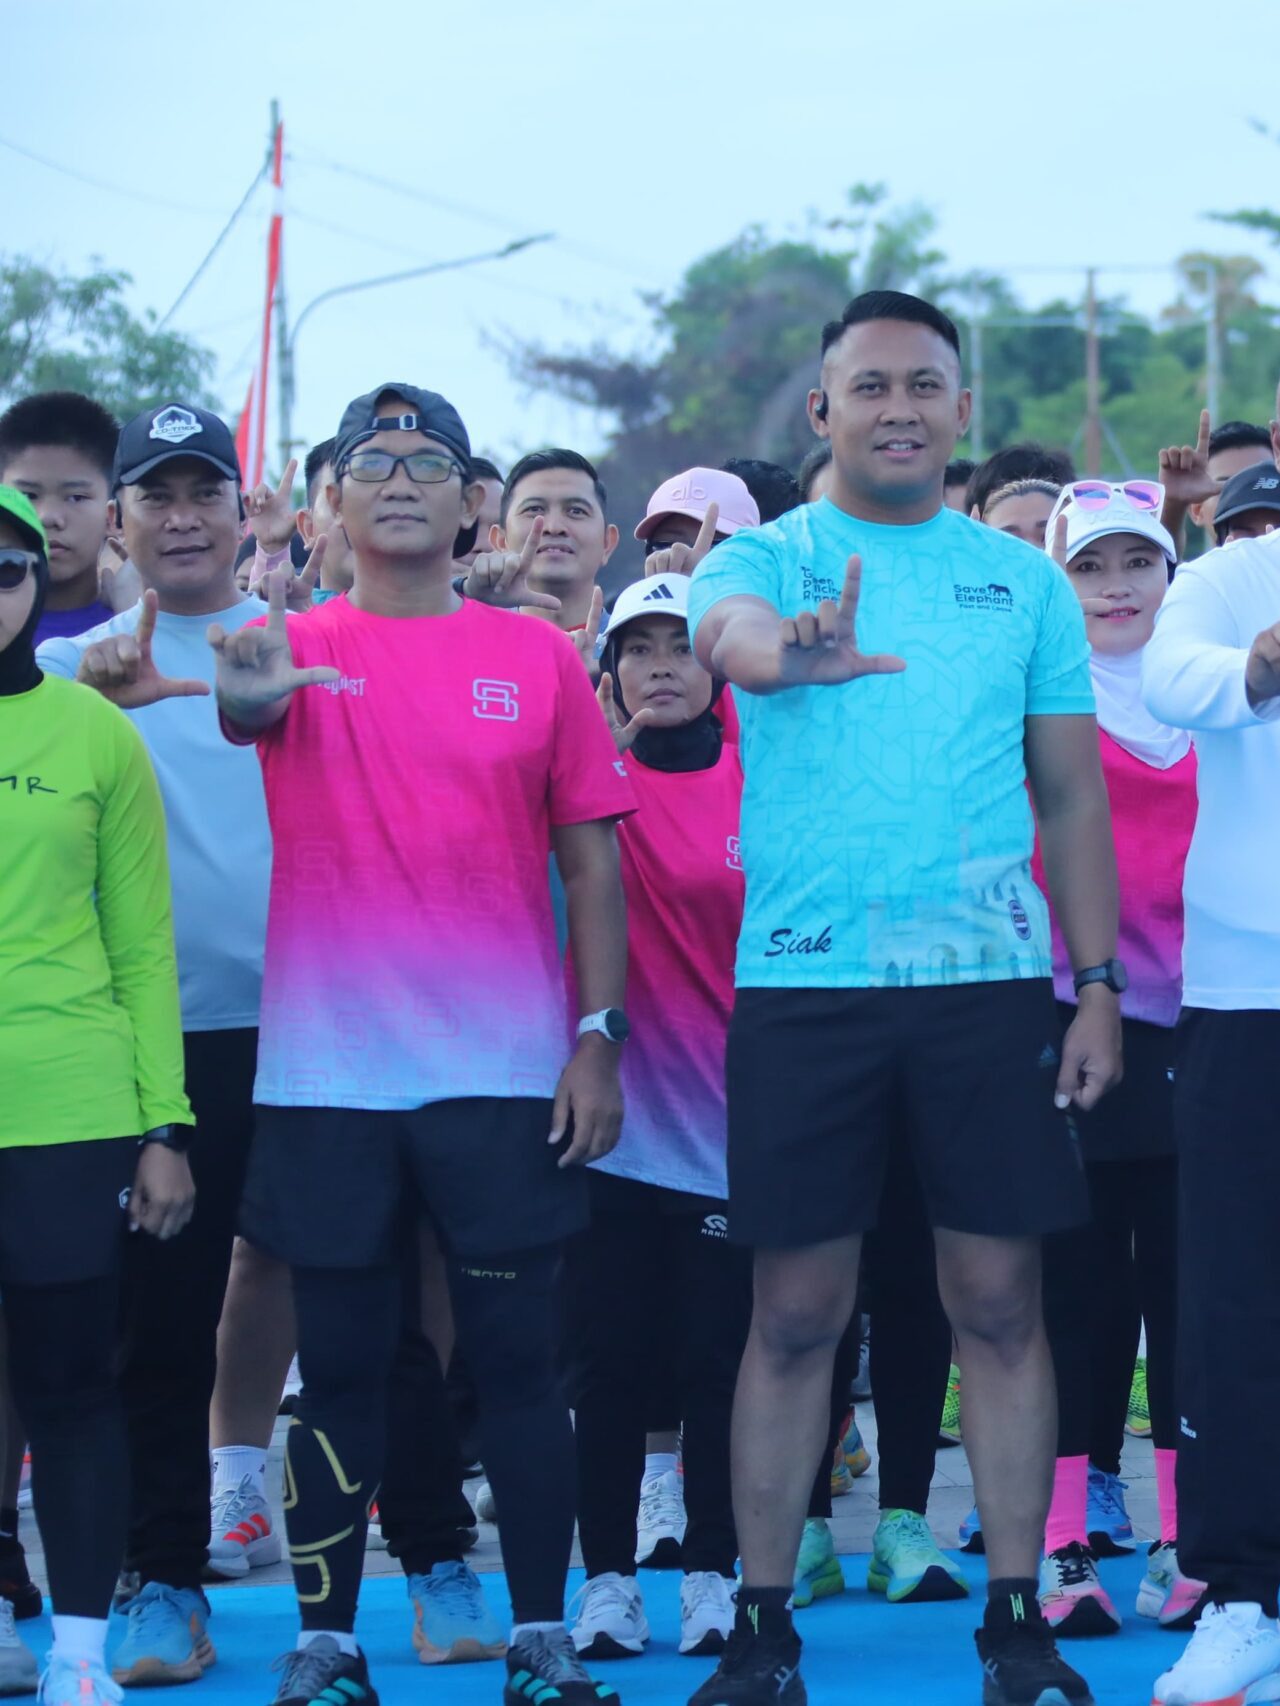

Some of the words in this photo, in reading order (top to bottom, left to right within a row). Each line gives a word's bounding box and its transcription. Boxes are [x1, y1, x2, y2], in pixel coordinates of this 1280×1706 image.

[953, 584, 986, 594] Save
[955, 593, 1014, 607] Elephant
[764, 925, 832, 957] Siak
